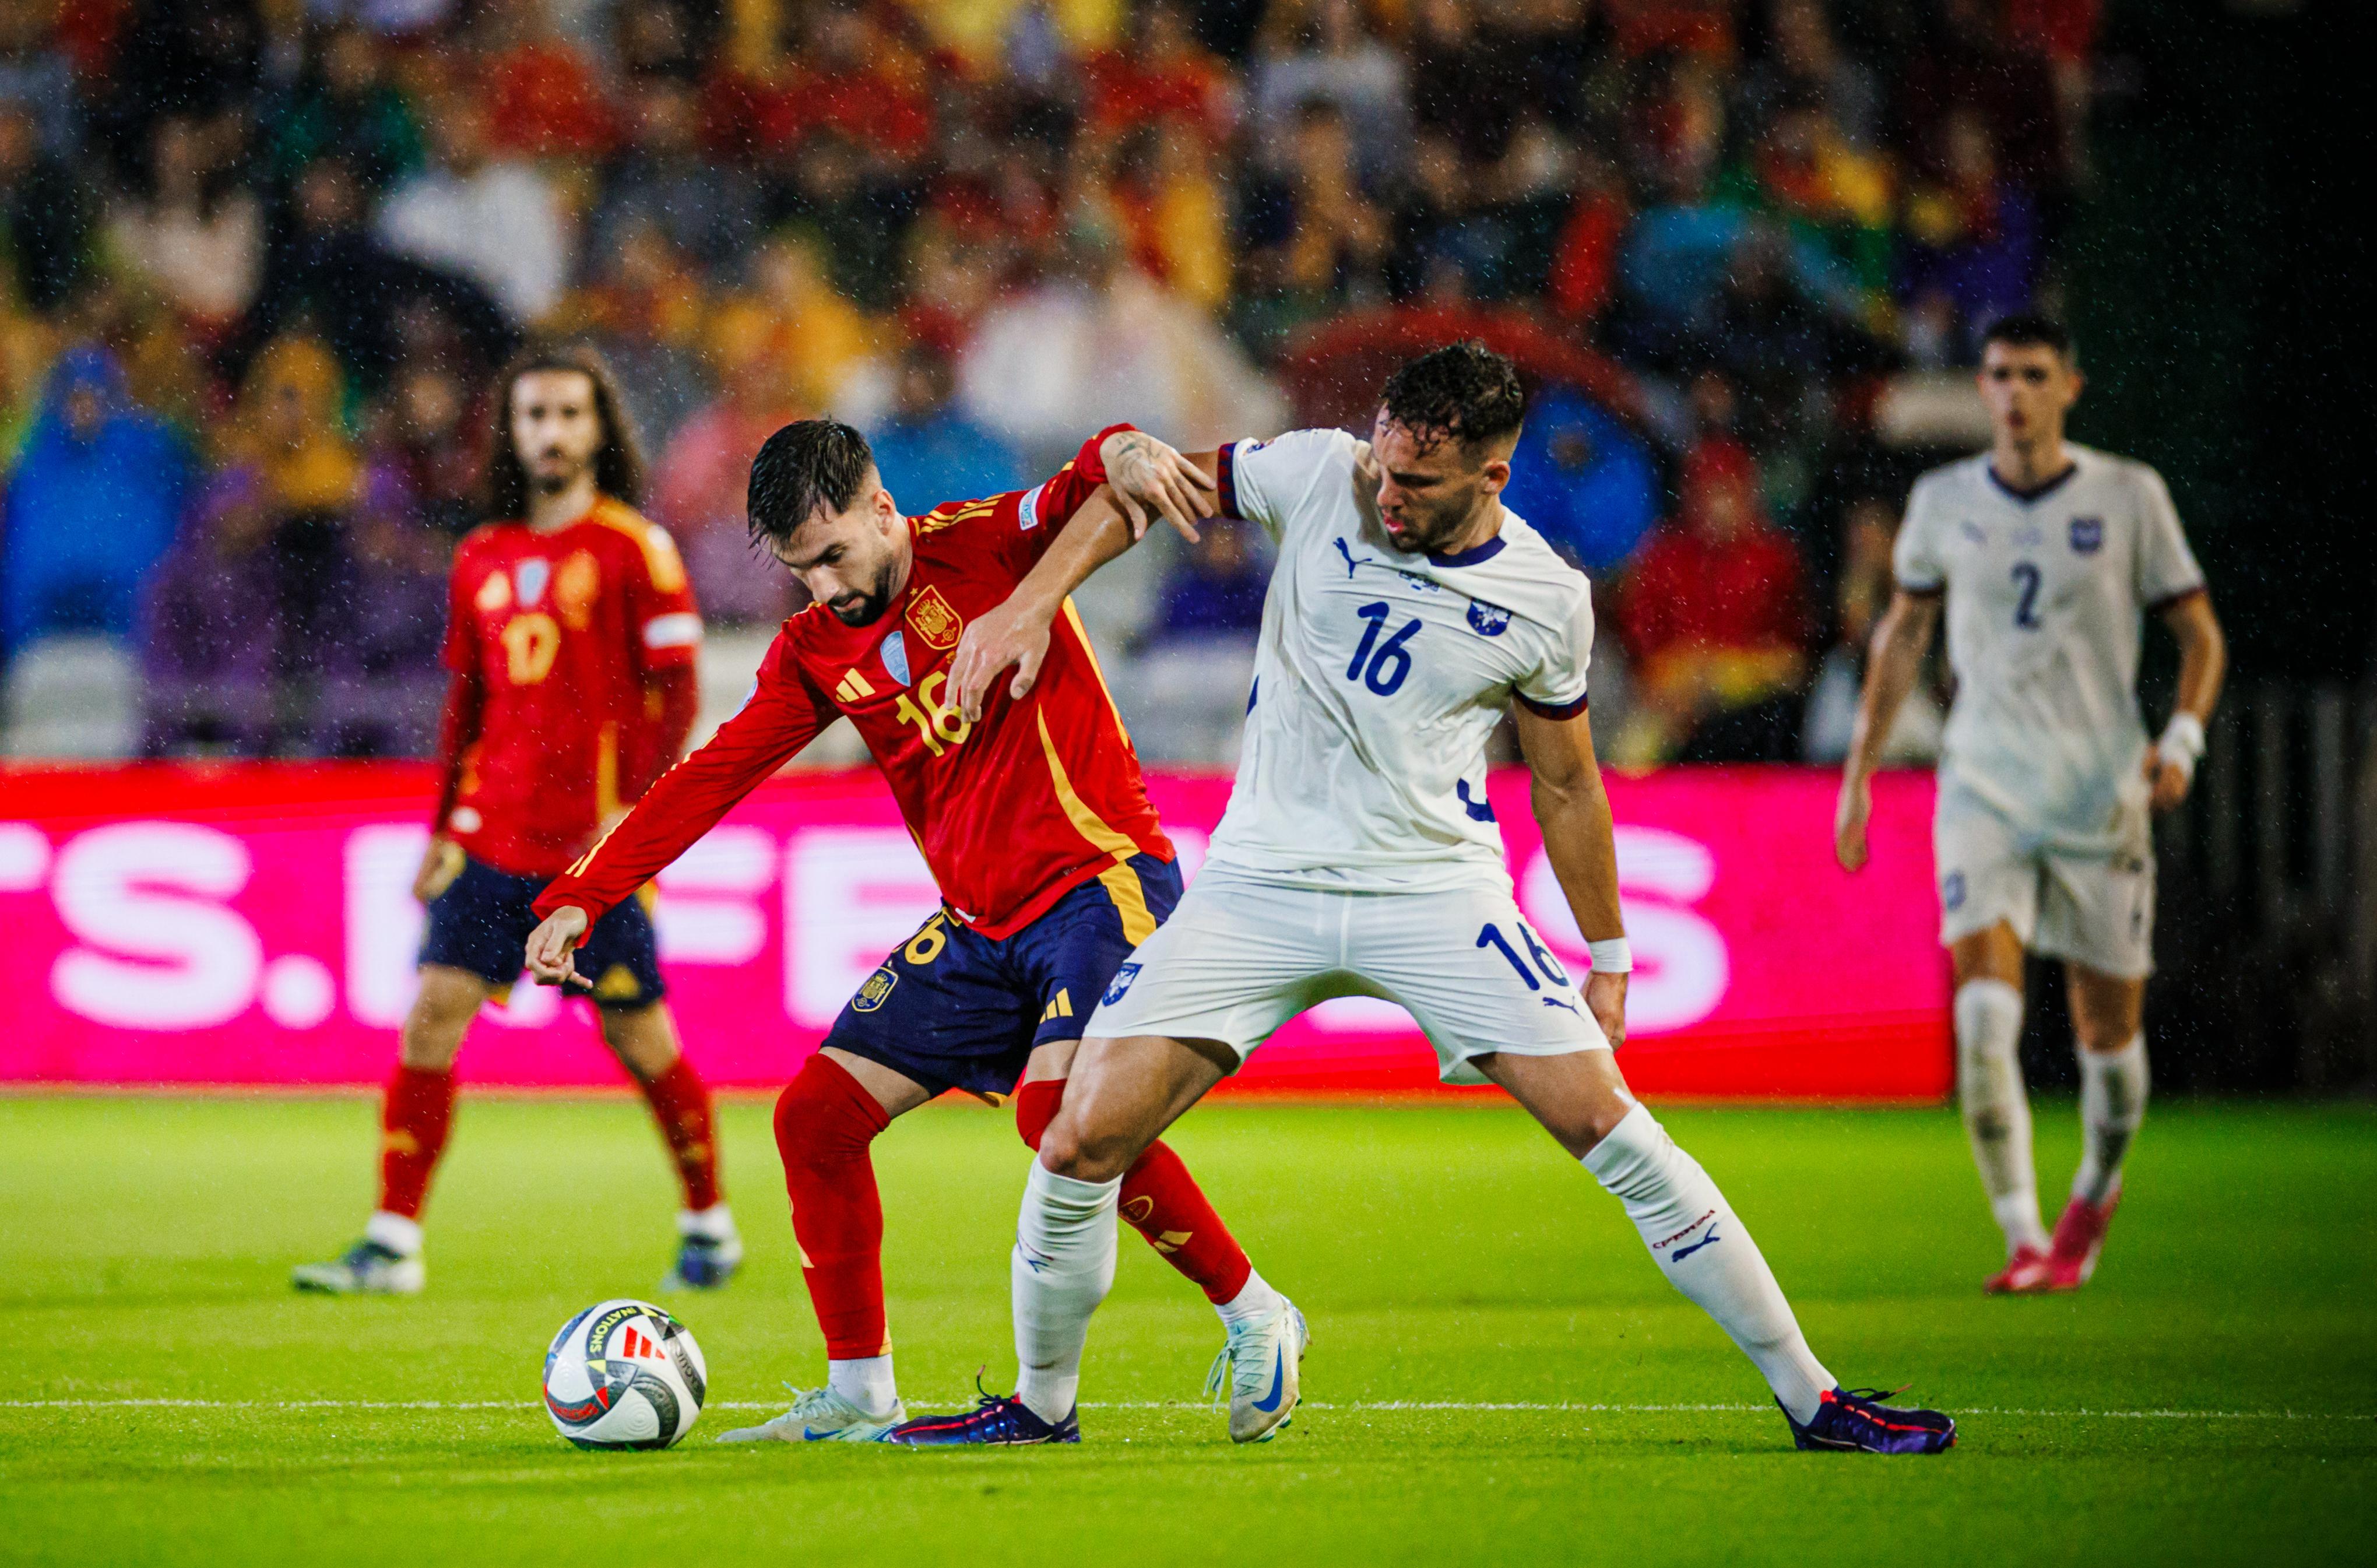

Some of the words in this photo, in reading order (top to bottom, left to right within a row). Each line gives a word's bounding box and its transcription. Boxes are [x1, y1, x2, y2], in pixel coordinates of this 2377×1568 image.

[2011, 560, 2041, 630] 2
[1346, 601, 1423, 697] 16
[895, 670, 972, 757] 16
[1476, 922, 1570, 991] 16
[589, 1306, 637, 1353] NATIONS
